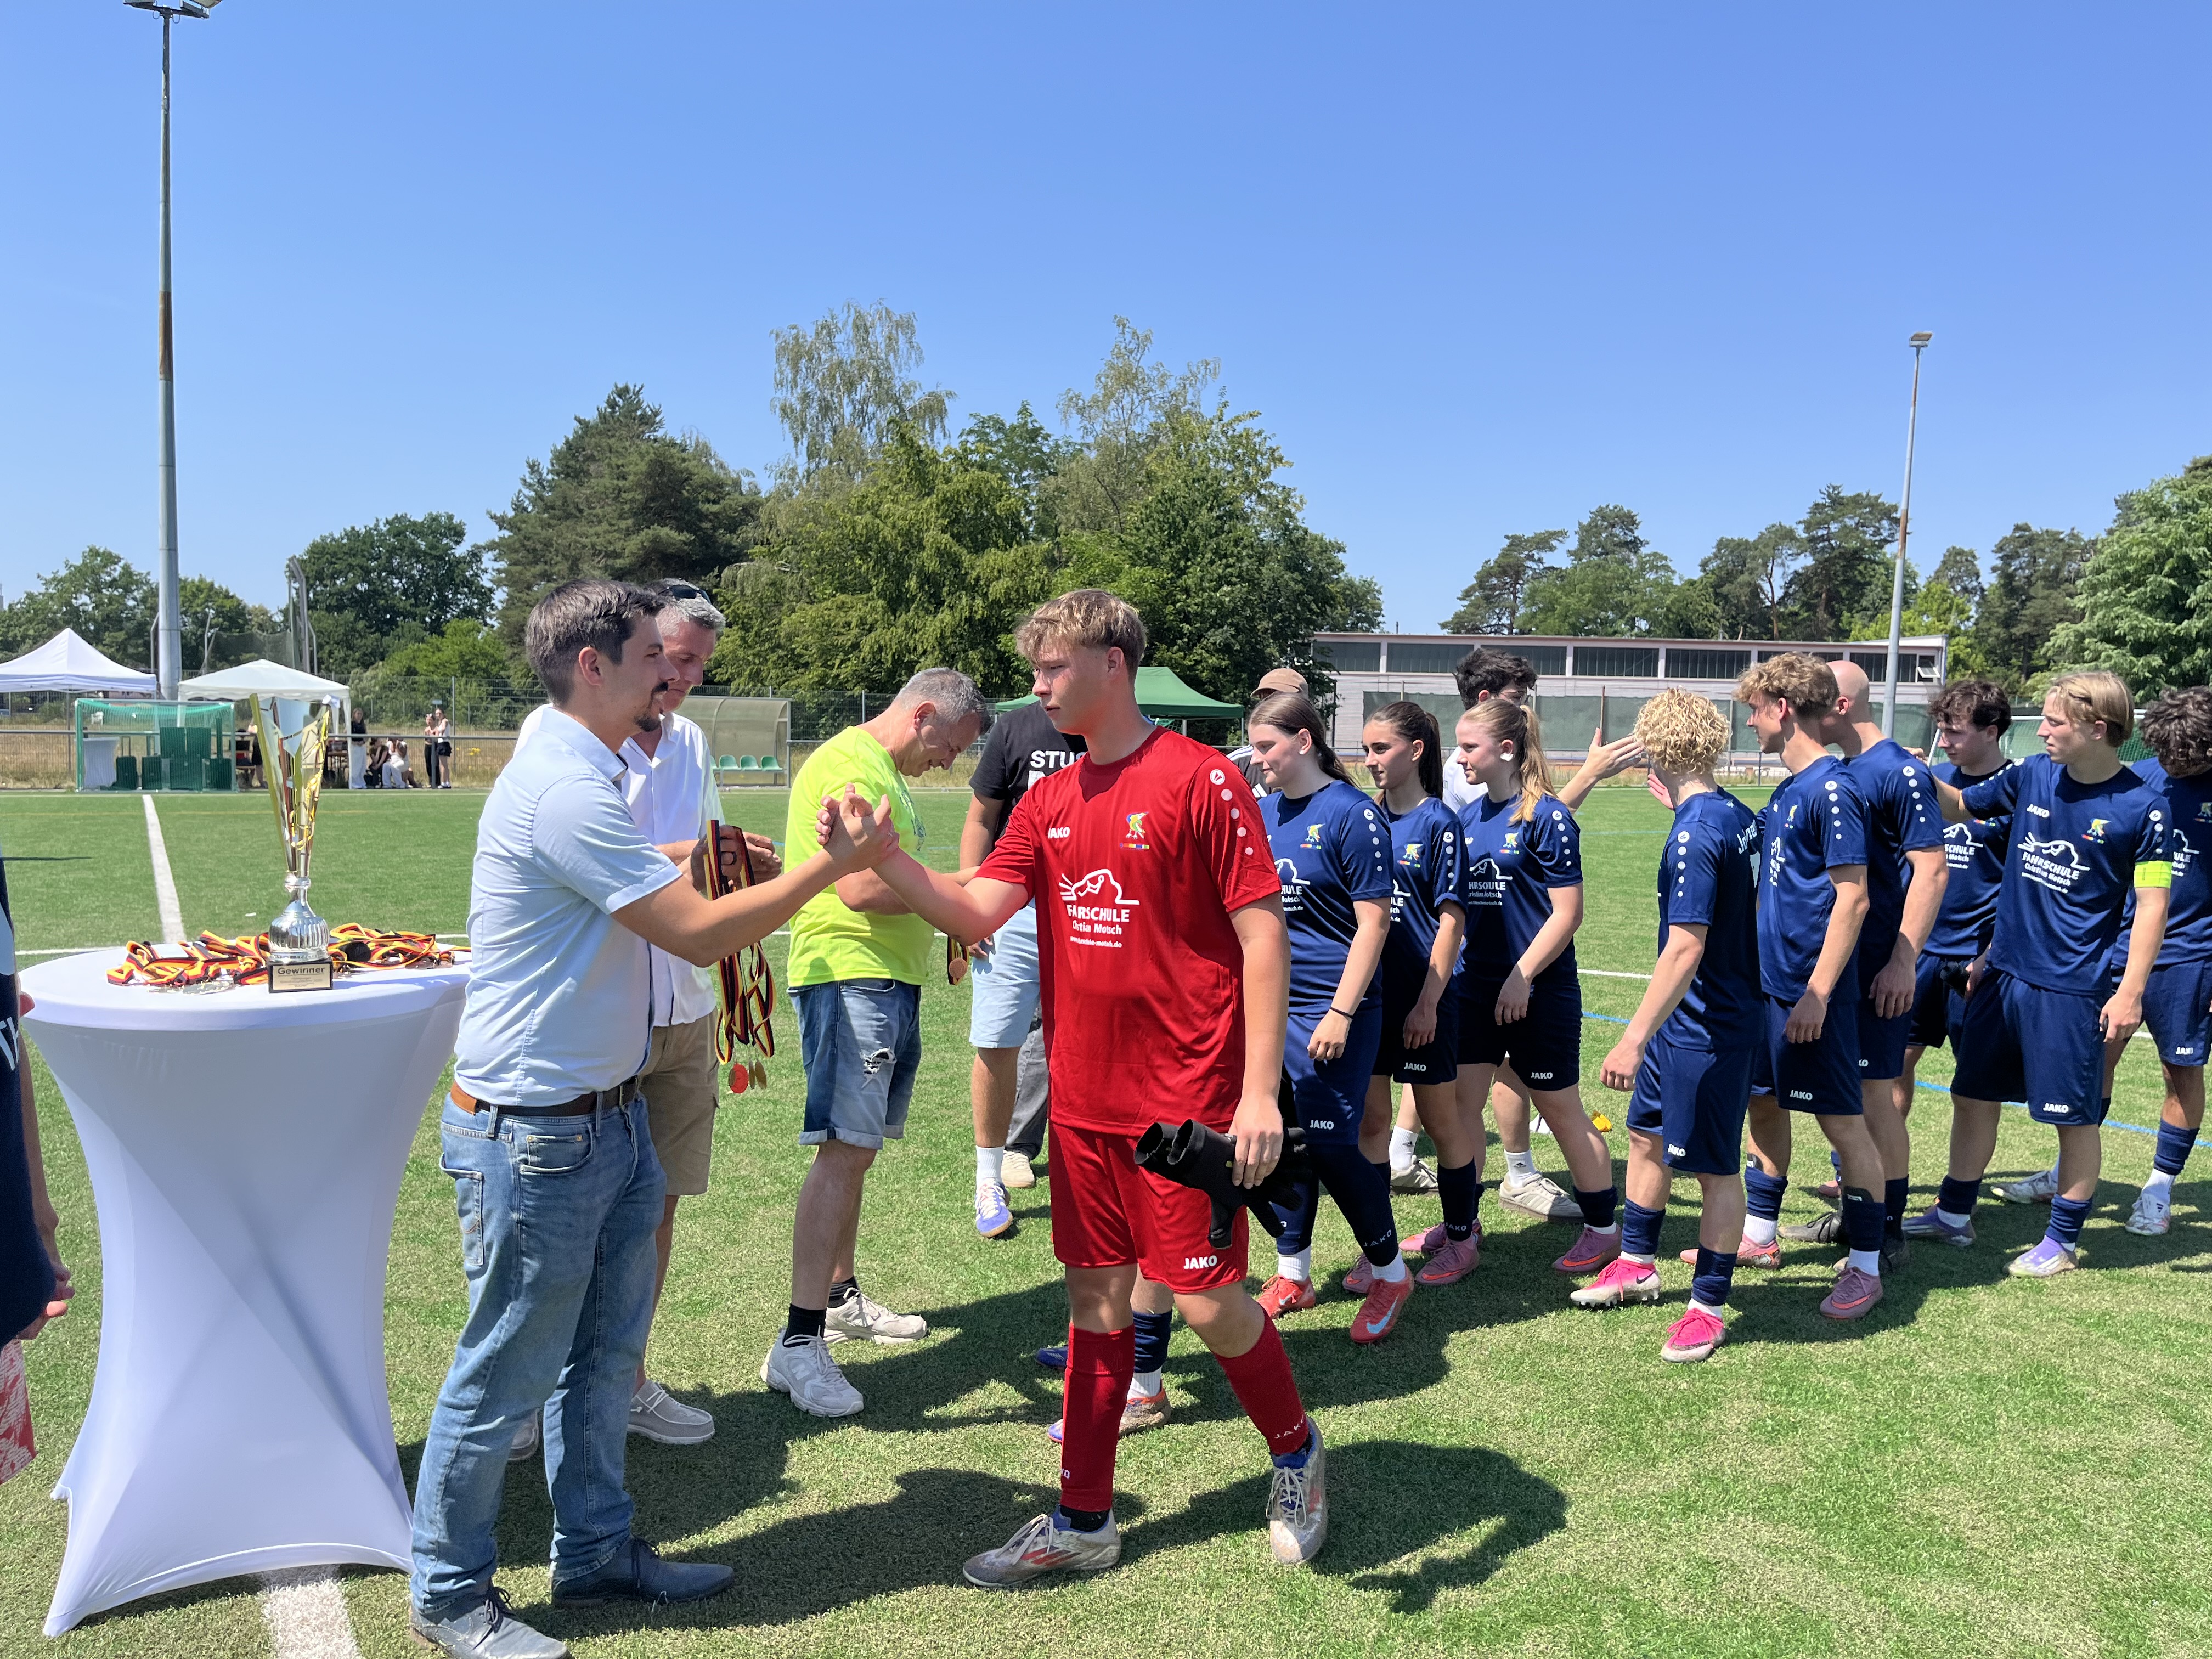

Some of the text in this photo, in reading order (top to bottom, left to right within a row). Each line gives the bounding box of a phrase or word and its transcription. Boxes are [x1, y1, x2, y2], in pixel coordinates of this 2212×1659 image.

[2027, 804, 2050, 818] JAKO
[1944, 843, 1975, 855] SCHULE
[2022, 851, 2080, 881] FAHRSCHULE
[1468, 881, 1506, 890] HRSCHULE
[1094, 923, 1122, 935] Motsch
[278, 966, 325, 975] Gewinner
[1404, 1062, 1427, 1071] JAKO
[1531, 1071, 1553, 1080] JAKO
[1789, 1090, 1813, 1101] JAKO
[2042, 1103, 2069, 1113] JAKO
[1310, 1119, 1334, 1130] JAKO
[1667, 1143, 1686, 1157] JAKO
[1183, 1255, 1217, 1270] JAKO
